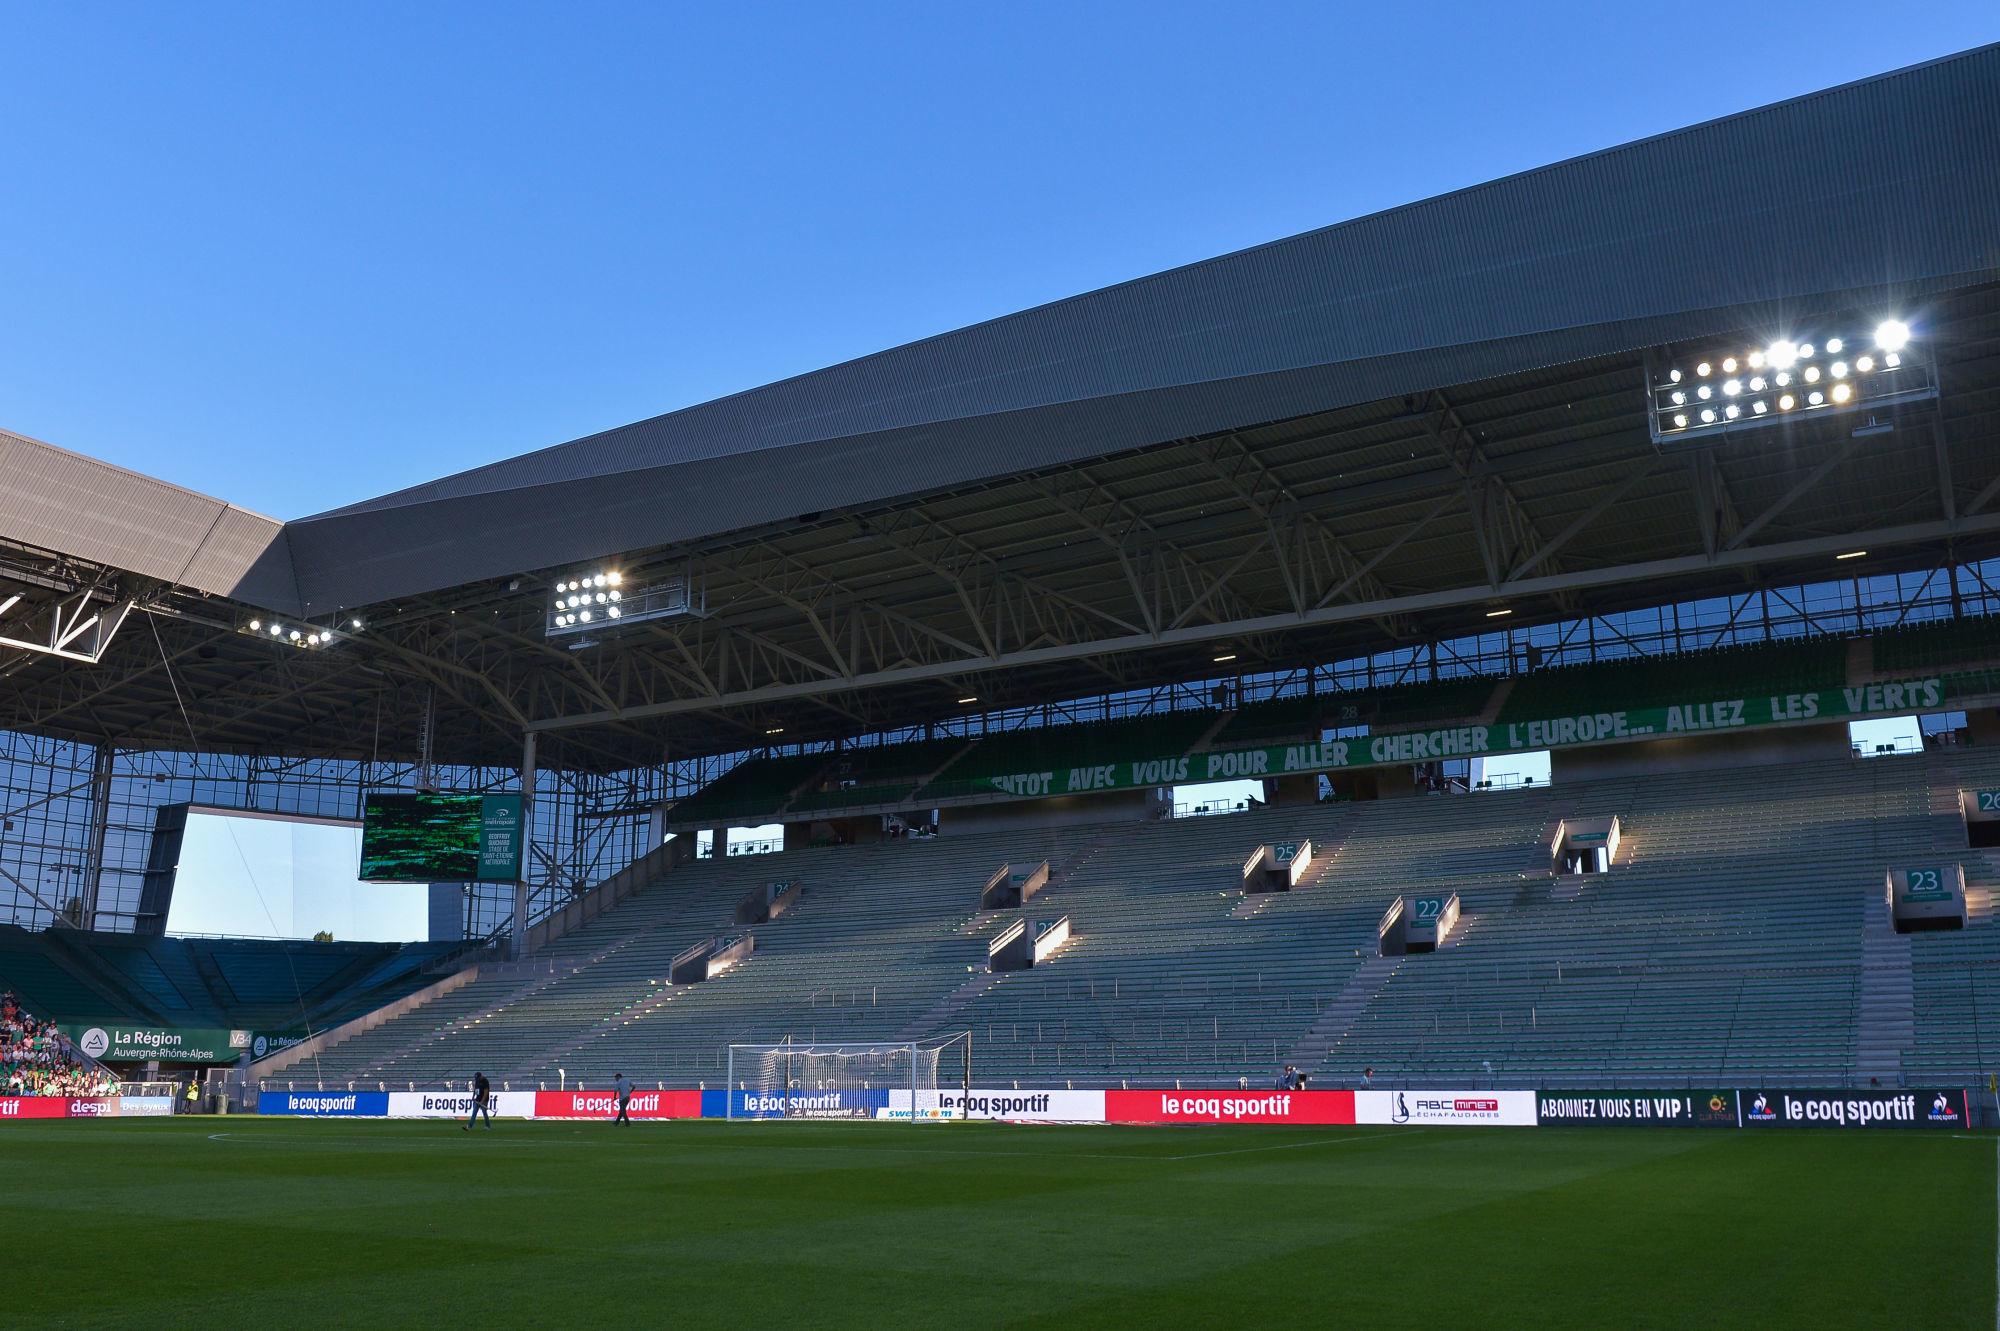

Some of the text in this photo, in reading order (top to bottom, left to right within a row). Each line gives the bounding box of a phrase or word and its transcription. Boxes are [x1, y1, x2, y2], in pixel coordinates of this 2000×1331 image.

[1341, 706, 1359, 720] 28
[1068, 764, 1115, 791] AVEC
[1132, 757, 1189, 785] VOUS
[1208, 750, 1268, 779] POUR
[1284, 741, 1348, 771] ALLER
[1371, 726, 1489, 762] CHERCHER
[1666, 699, 1745, 732] ALLEZ
[1770, 692, 1819, 721] LES
[1843, 679, 1940, 713] VERTS
[1277, 846, 1294, 862] 25
[1911, 871, 1938, 891] 23
[1418, 900, 1439, 918] 22
[114, 1030, 182, 1048] La Région
[231, 1031, 252, 1045] V34
[269, 1037, 278, 1046] La
[113, 1048, 213, 1060] Auvergne-Rhône-Alpes
[0, 1100, 20, 1115] tif
[70, 1099, 112, 1117] despi
[288, 1094, 356, 1113] le coq sportif
[423, 1095, 498, 1113] le coq spif
[573, 1094, 659, 1114] le coq sortif
[744, 1093, 758, 1111] le
[939, 1093, 954, 1108] le
[991, 1094, 1050, 1115] sportif
[1161, 1094, 1291, 1118] le coq sportif
[1416, 1100, 1453, 1110] ABC
[1541, 1097, 1692, 1118] ABONNEZ VOUS EN VIP !
[1784, 1095, 1915, 1126] le coq sportif
